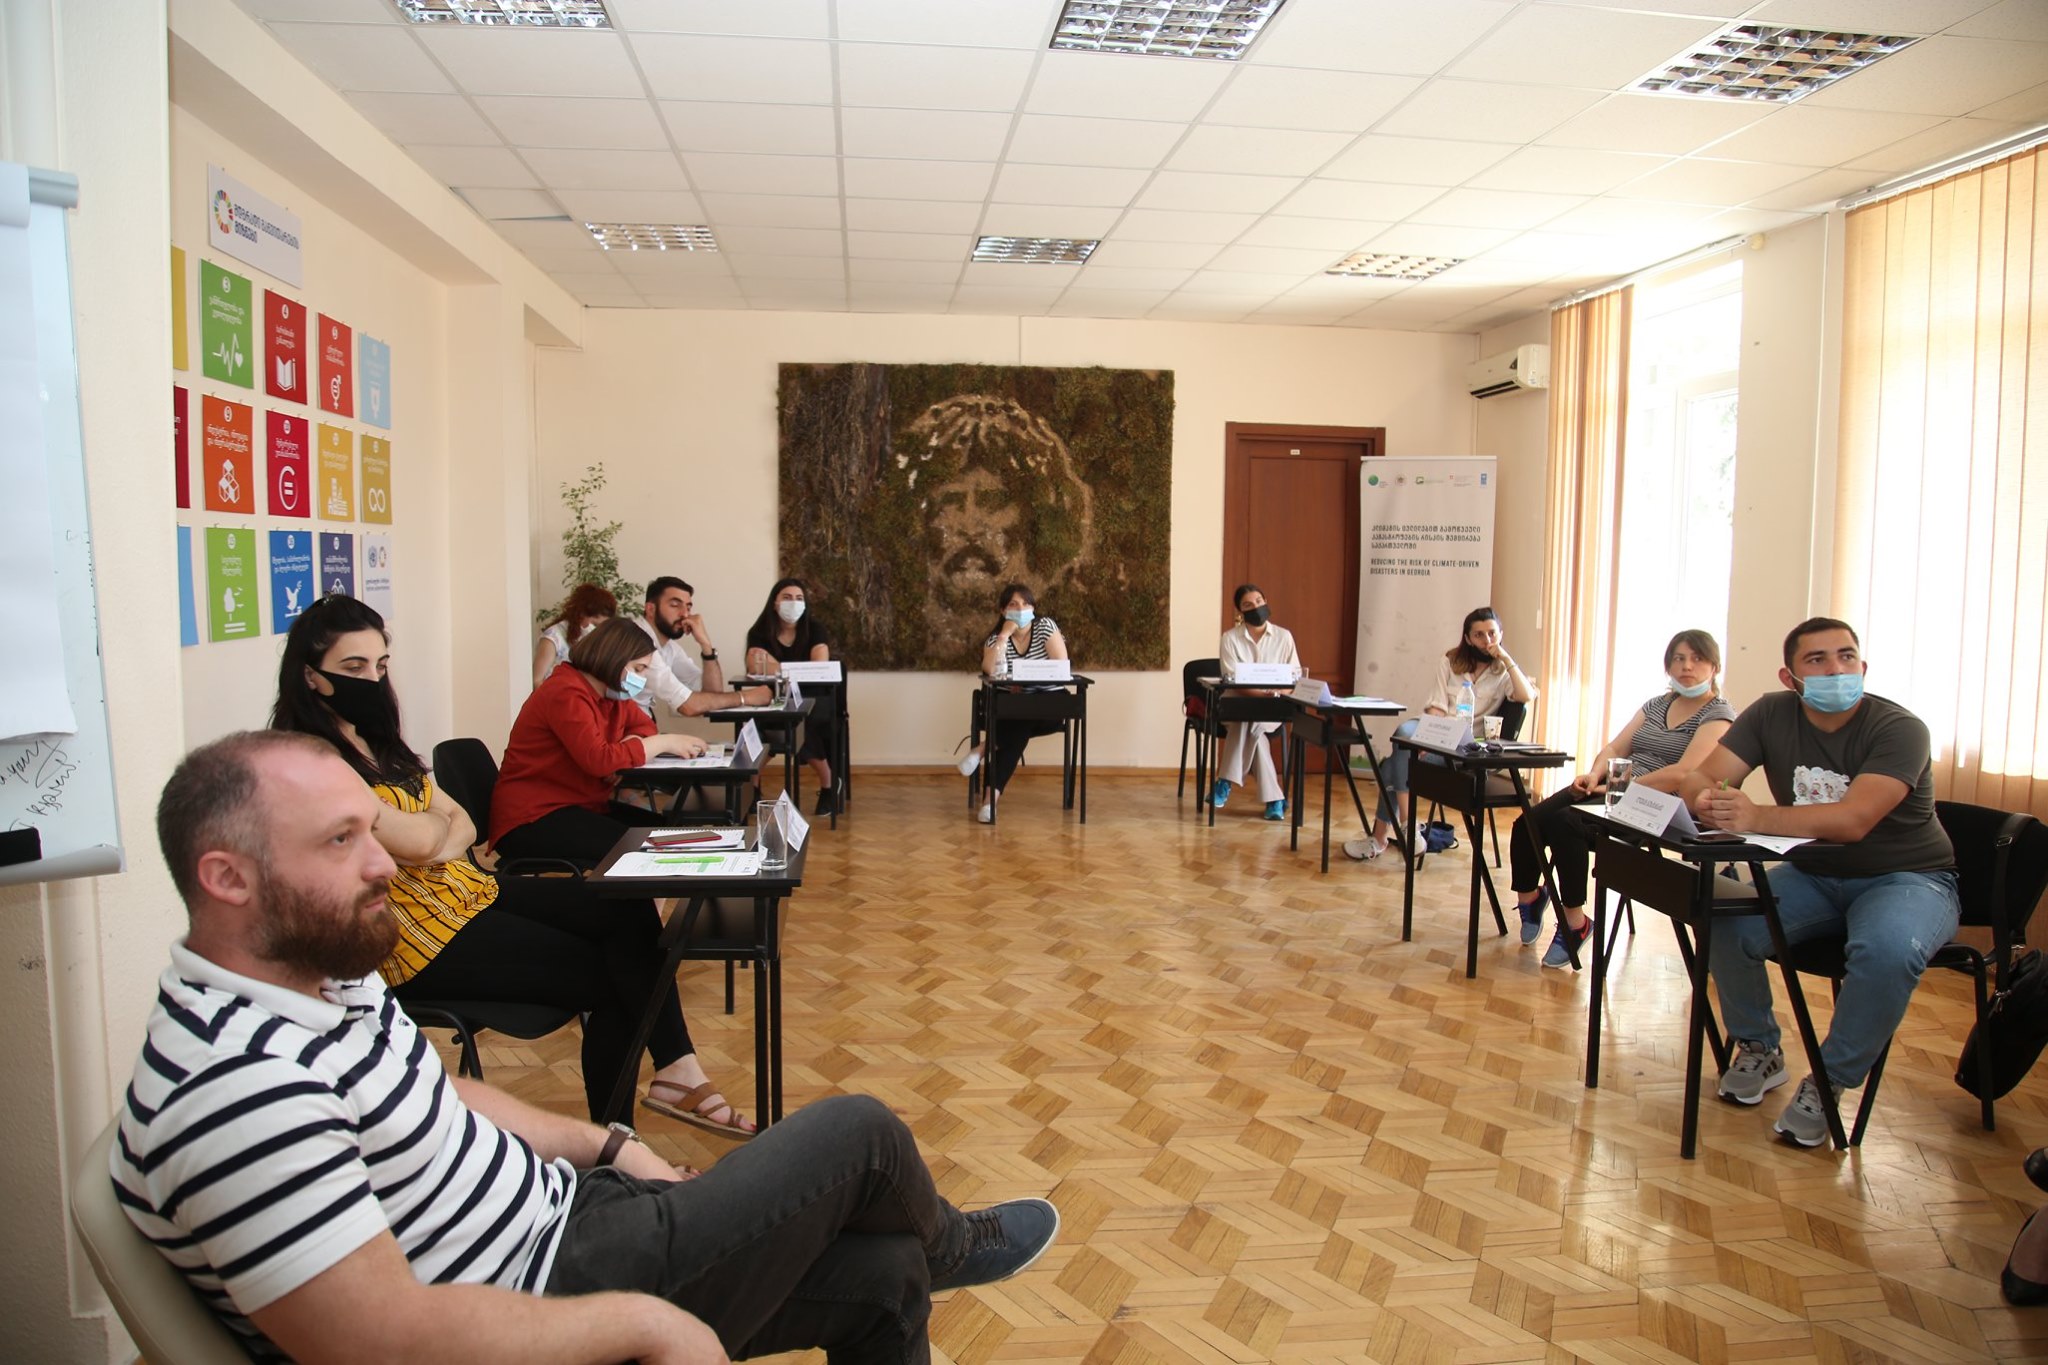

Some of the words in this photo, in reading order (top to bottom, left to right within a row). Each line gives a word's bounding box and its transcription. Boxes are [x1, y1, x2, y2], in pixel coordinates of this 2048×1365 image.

[1370, 558, 1396, 566] REDUCING
[1397, 558, 1407, 566] THE
[1370, 567, 1398, 575] DISASTERS
